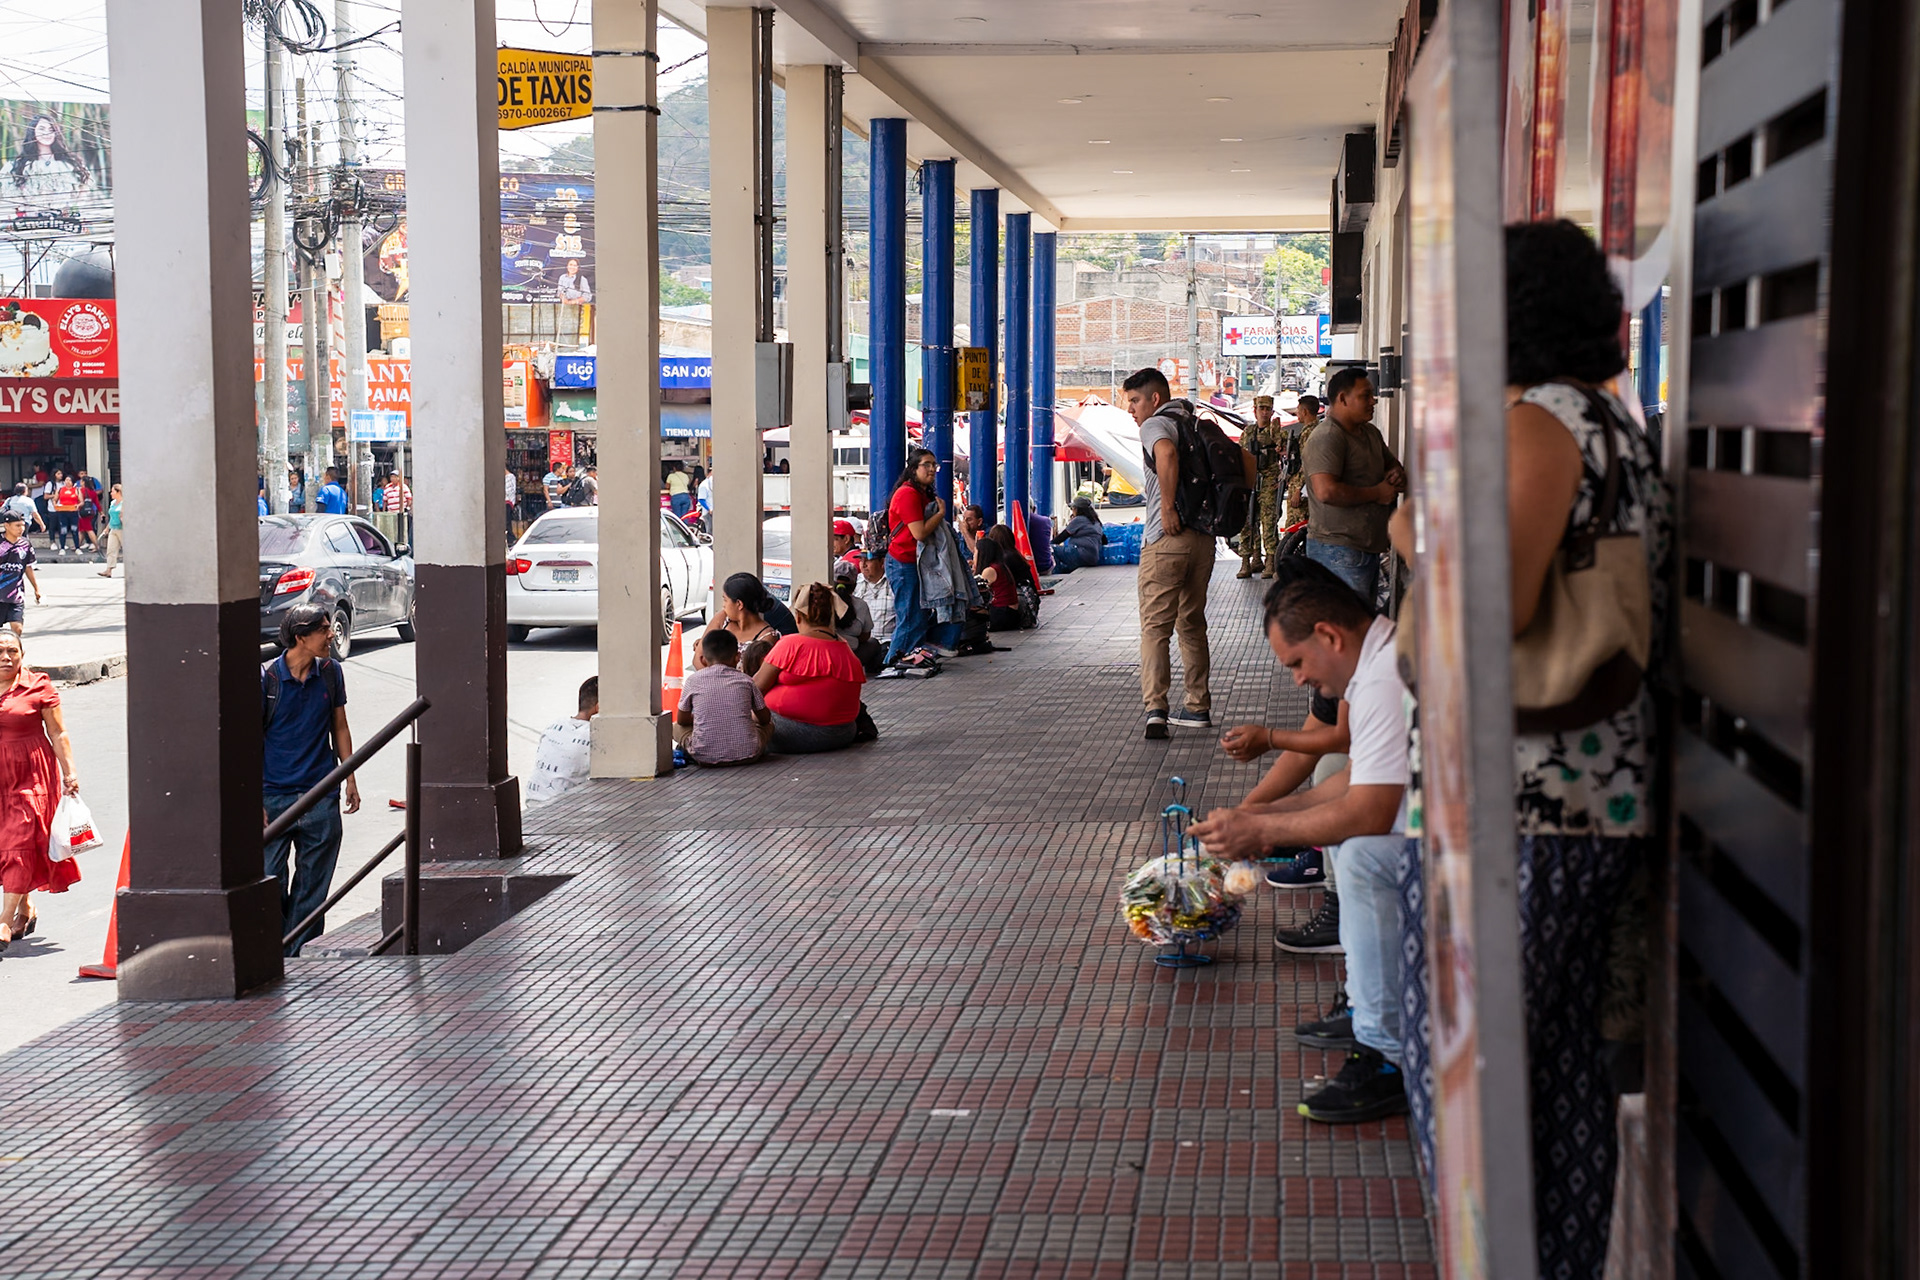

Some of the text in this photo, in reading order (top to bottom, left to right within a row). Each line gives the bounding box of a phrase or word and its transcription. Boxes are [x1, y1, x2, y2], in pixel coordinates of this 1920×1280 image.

[498, 58, 592, 74] CALDÍA MUNICIPAL
[498, 74, 592, 106] DE TAXIS
[60, 303, 110, 331] ELLY'S CAKES
[1243, 326, 1307, 335] FARMCIAS
[965, 351, 987, 363] PUNTO
[662, 365, 689, 377] SAN
[972, 368, 981, 378] DE
[969, 383, 985, 392] TAXI
[53, 387, 119, 414] CAKE
[665, 428, 710, 437] TIENDA SAN
